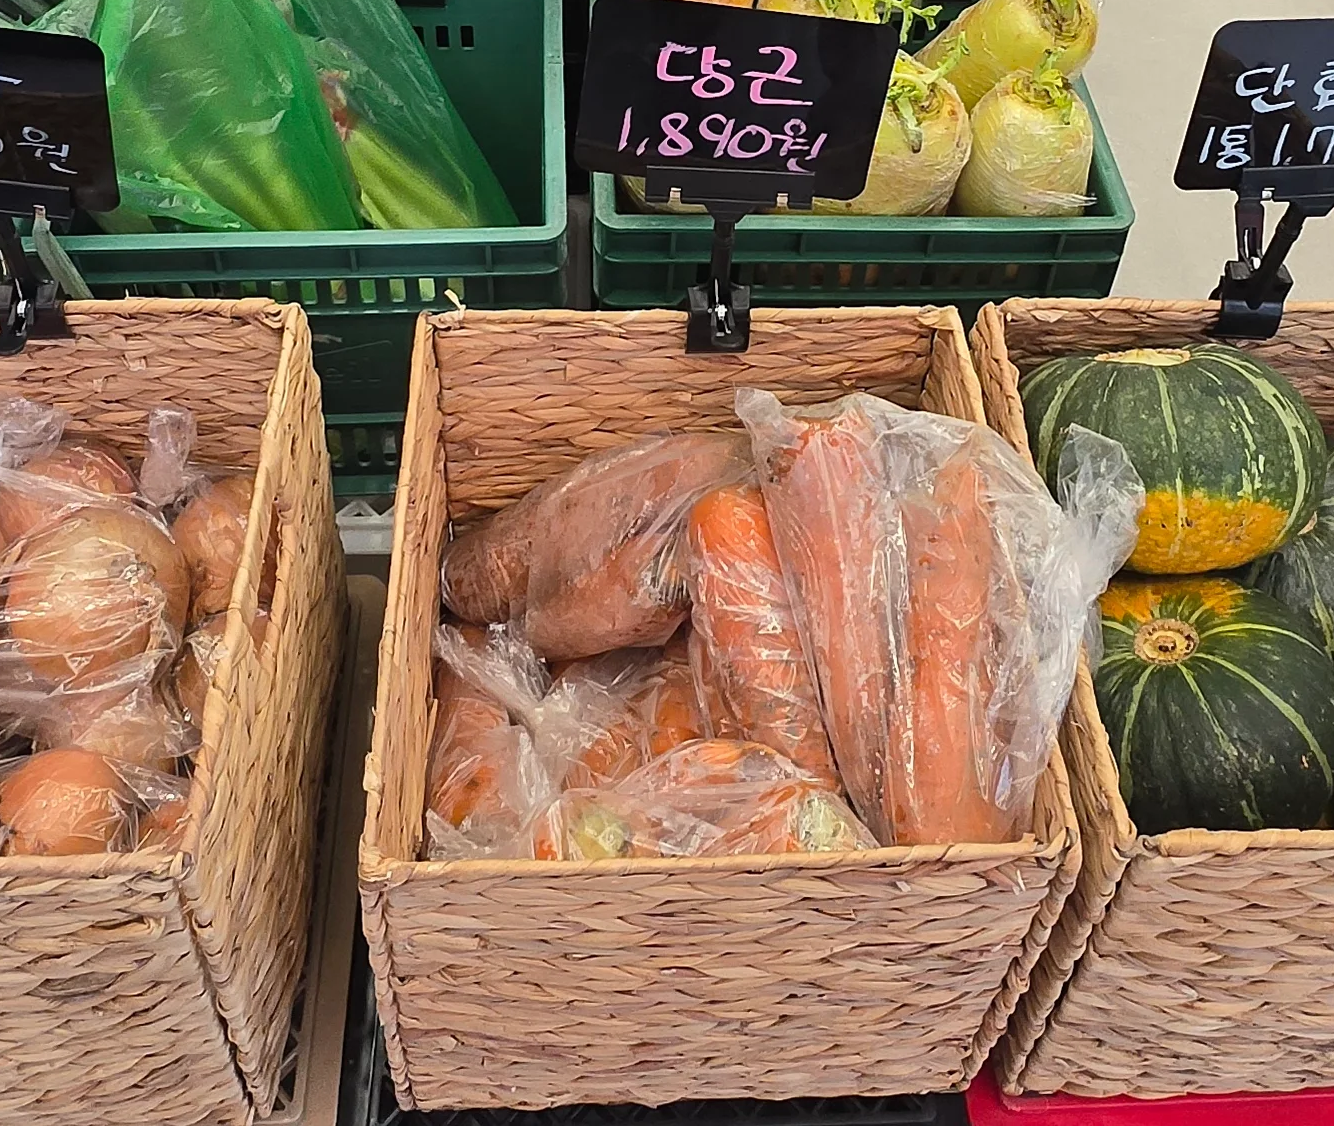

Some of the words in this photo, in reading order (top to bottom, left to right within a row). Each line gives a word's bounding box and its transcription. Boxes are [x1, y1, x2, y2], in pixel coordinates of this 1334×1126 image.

[656, 41, 814, 106] 당근
[617, 106, 828, 173] 1,890원
[1198, 124, 1253, 170] 1통
